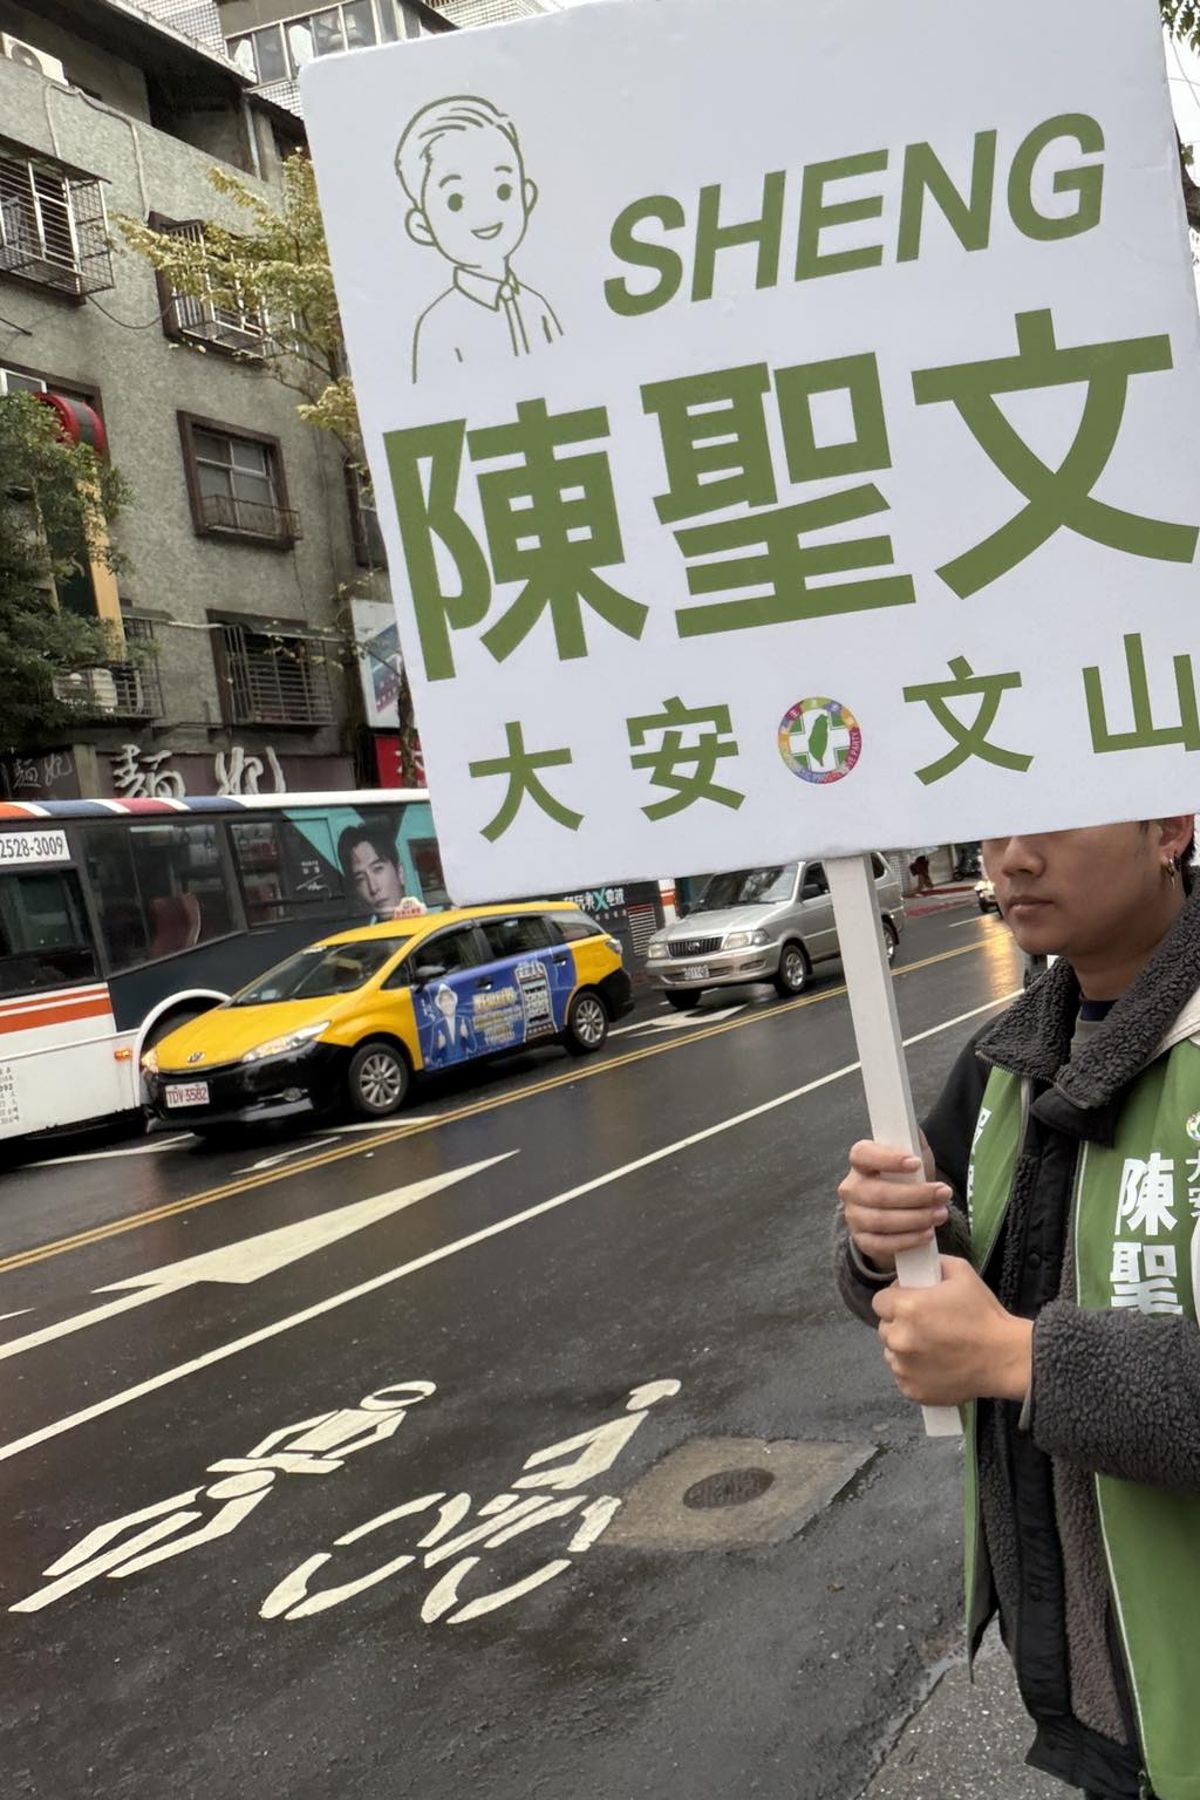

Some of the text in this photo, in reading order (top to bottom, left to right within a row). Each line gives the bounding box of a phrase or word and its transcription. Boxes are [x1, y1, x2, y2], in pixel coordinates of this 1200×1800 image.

[603, 112, 1106, 317] SHENG
[382, 307, 1200, 683] 陳聖文
[0, 835, 65, 859] 2528-3009
[469, 696, 745, 842] 大安
